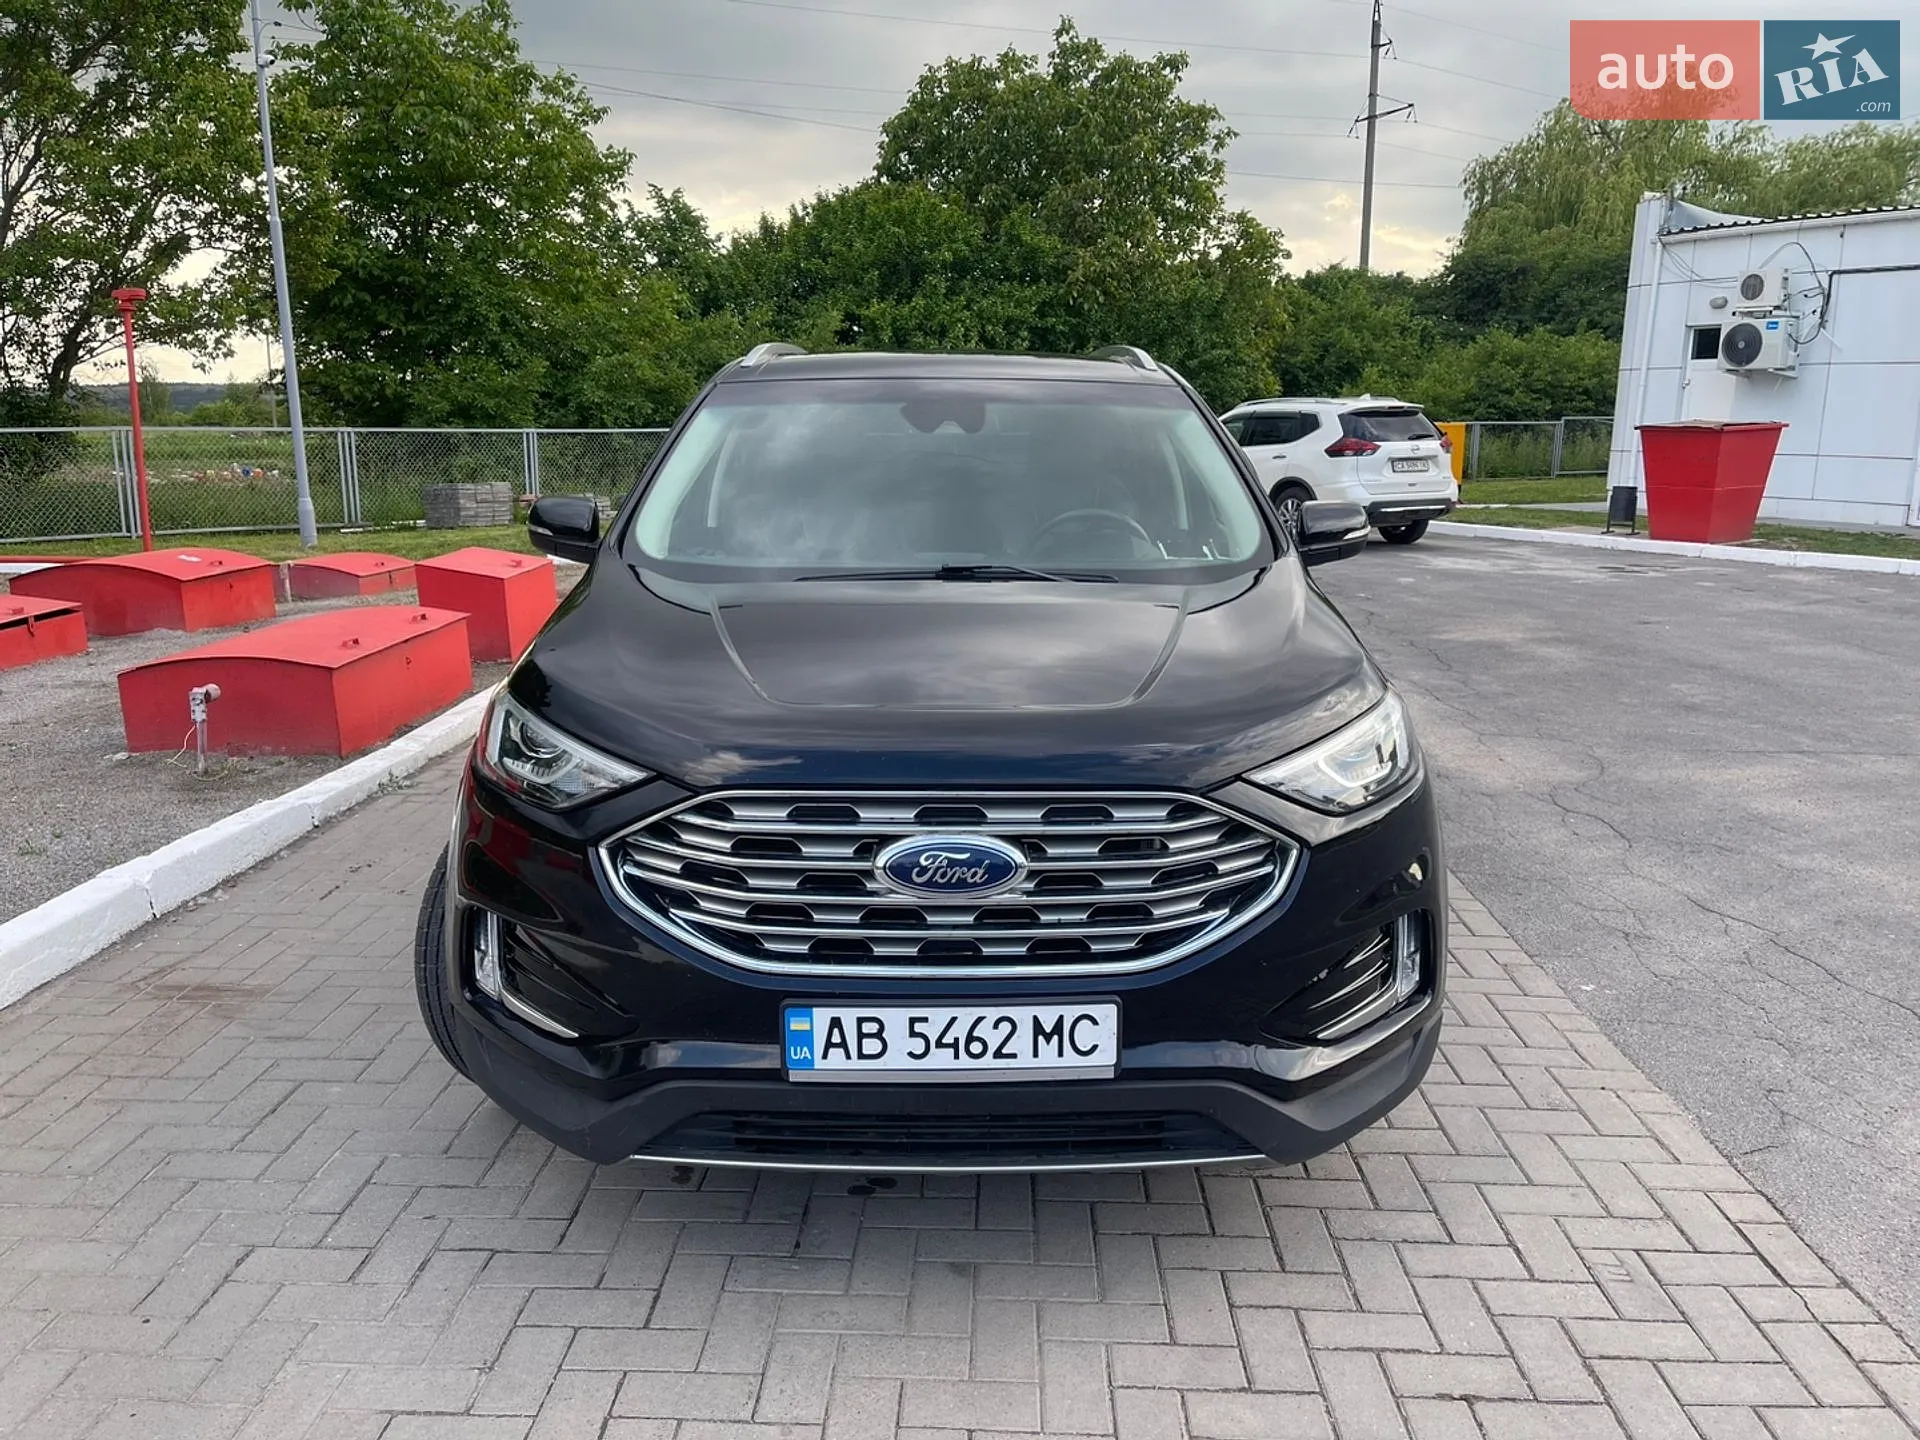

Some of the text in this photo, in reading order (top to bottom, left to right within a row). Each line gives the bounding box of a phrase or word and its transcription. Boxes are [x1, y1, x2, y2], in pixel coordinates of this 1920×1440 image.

[911, 850, 991, 884] Ford
[790, 1046, 812, 1060] UA
[821, 1013, 1100, 1061] AB 5462 MC
